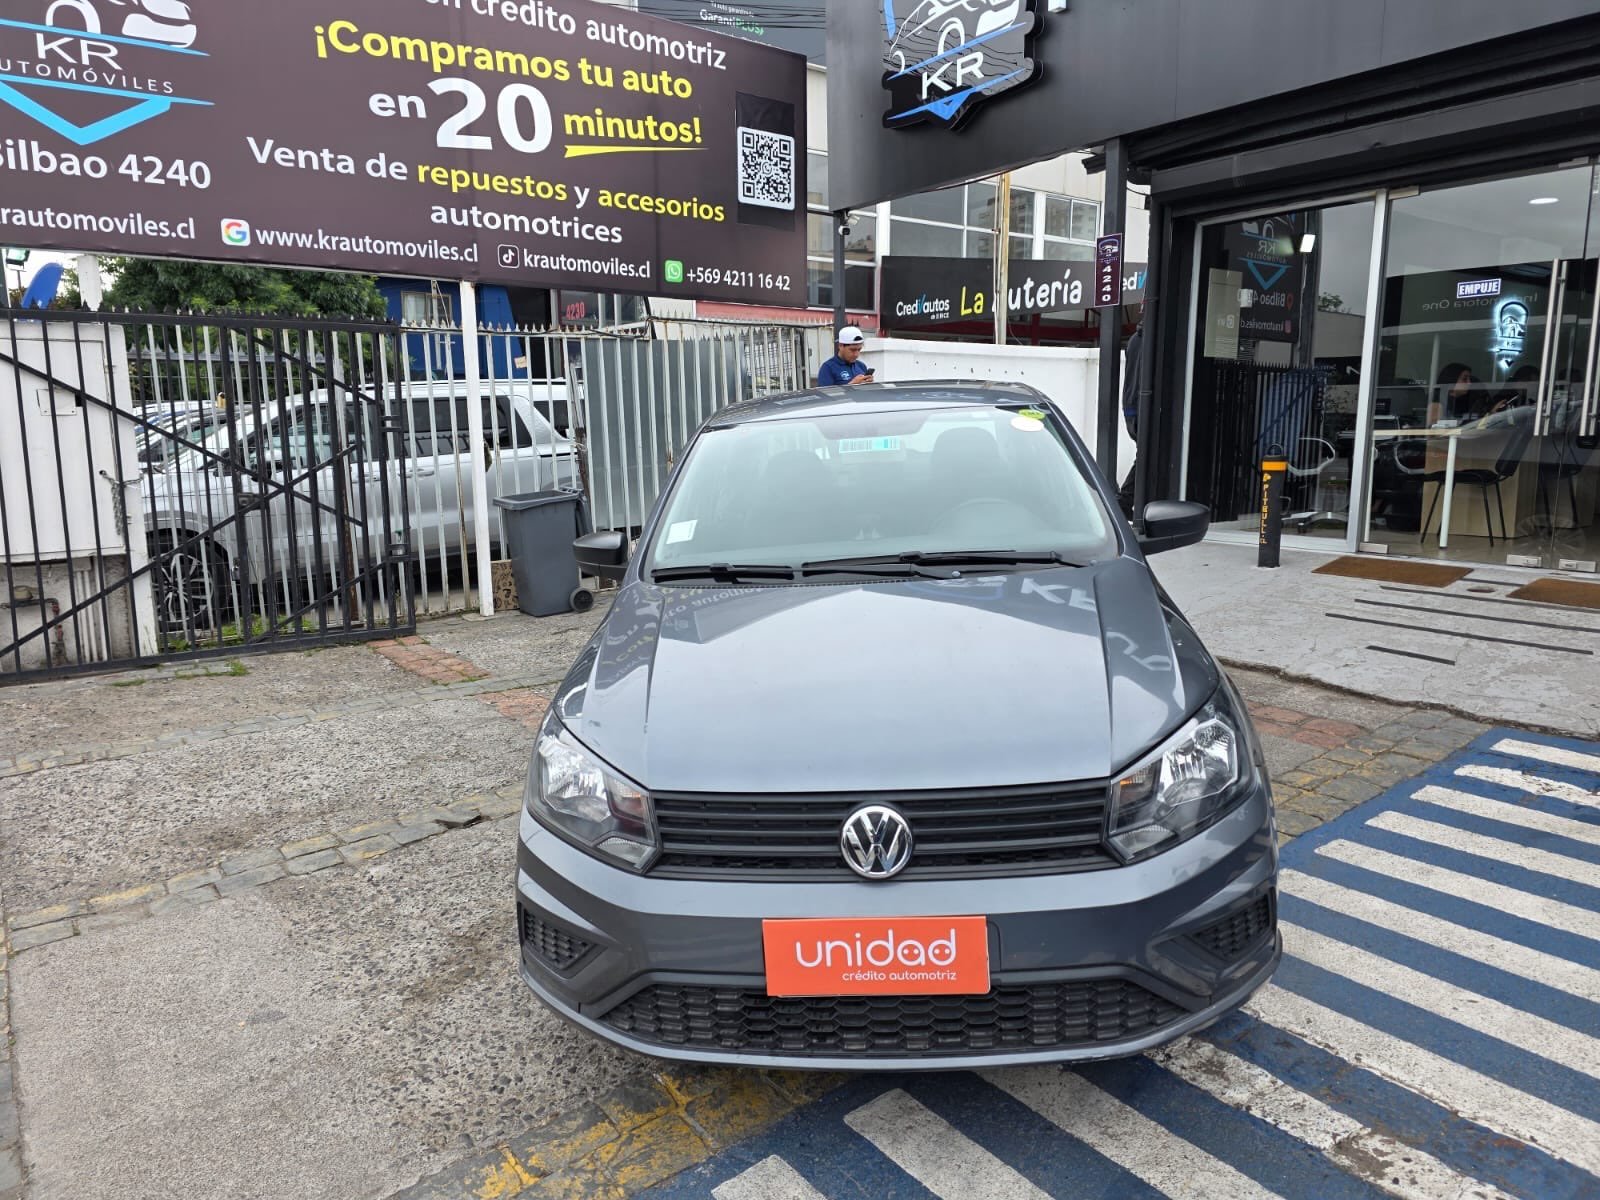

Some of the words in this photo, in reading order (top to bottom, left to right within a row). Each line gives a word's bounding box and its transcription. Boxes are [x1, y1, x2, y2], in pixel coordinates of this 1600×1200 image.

[36, 33, 122, 70] KR
[314, 20, 570, 81] ¡Compramos
[578, 57, 614, 87] tu
[622, 69, 692, 98] auto
[586, 19, 726, 70] automotriz
[922, 52, 984, 99] KR
[369, 93, 427, 118] en
[427, 77, 553, 154] 20
[564, 109, 702, 143] minutos!
[118, 154, 211, 189] 4240
[246, 136, 355, 175] Venta
[365, 152, 408, 180] de
[417, 164, 567, 200] repuestos
[574, 186, 589, 208] y
[598, 190, 725, 222] accesorios
[430, 205, 622, 243] automotrices
[255, 229, 478, 262] www.krautomoviles.cl
[524, 248, 651, 278] krautomoviles.cl
[687, 267, 721, 284] +569
[724, 270, 753, 287] 4211
[758, 273, 773, 289] 16
[775, 275, 790, 291] 42
[961, 286, 984, 316] La
[992, 268, 1083, 314] utería
[1102, 265, 1112, 302] 4240
[1459, 281, 1498, 295] EMPUJE
[565, 302, 585, 320] 4230
[796, 928, 957, 967] unidad
[842, 970, 886, 981] crédito
[889, 970, 957, 981] automotriz
